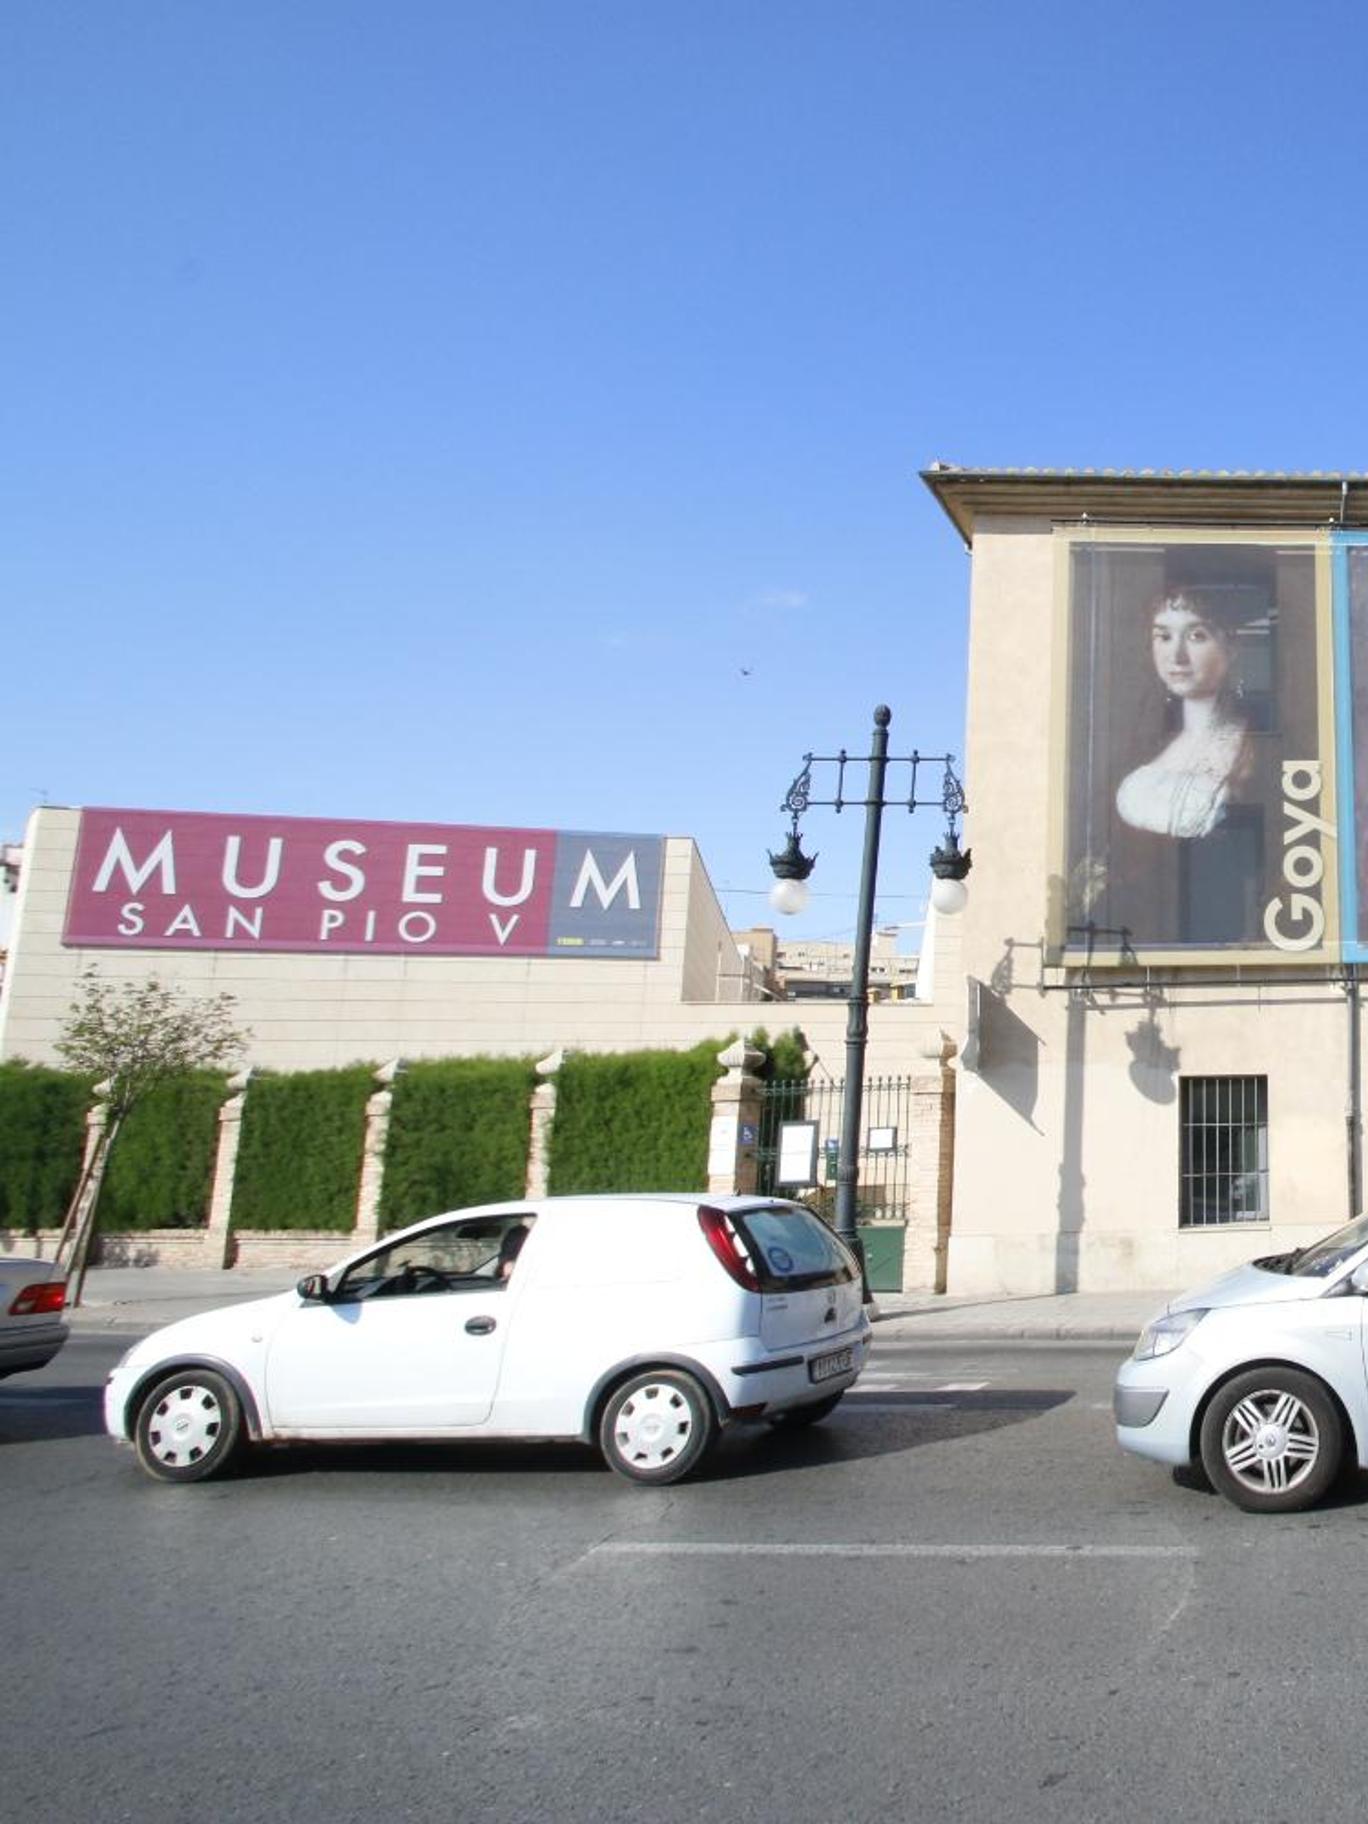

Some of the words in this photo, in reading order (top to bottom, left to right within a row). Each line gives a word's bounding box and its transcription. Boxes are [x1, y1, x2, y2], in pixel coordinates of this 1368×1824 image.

[92, 827, 641, 910] MUSEUM
[1264, 760, 1337, 951] Goya
[117, 902, 263, 939] SAN
[319, 909, 437, 942] PIO
[488, 913, 520, 946] V
